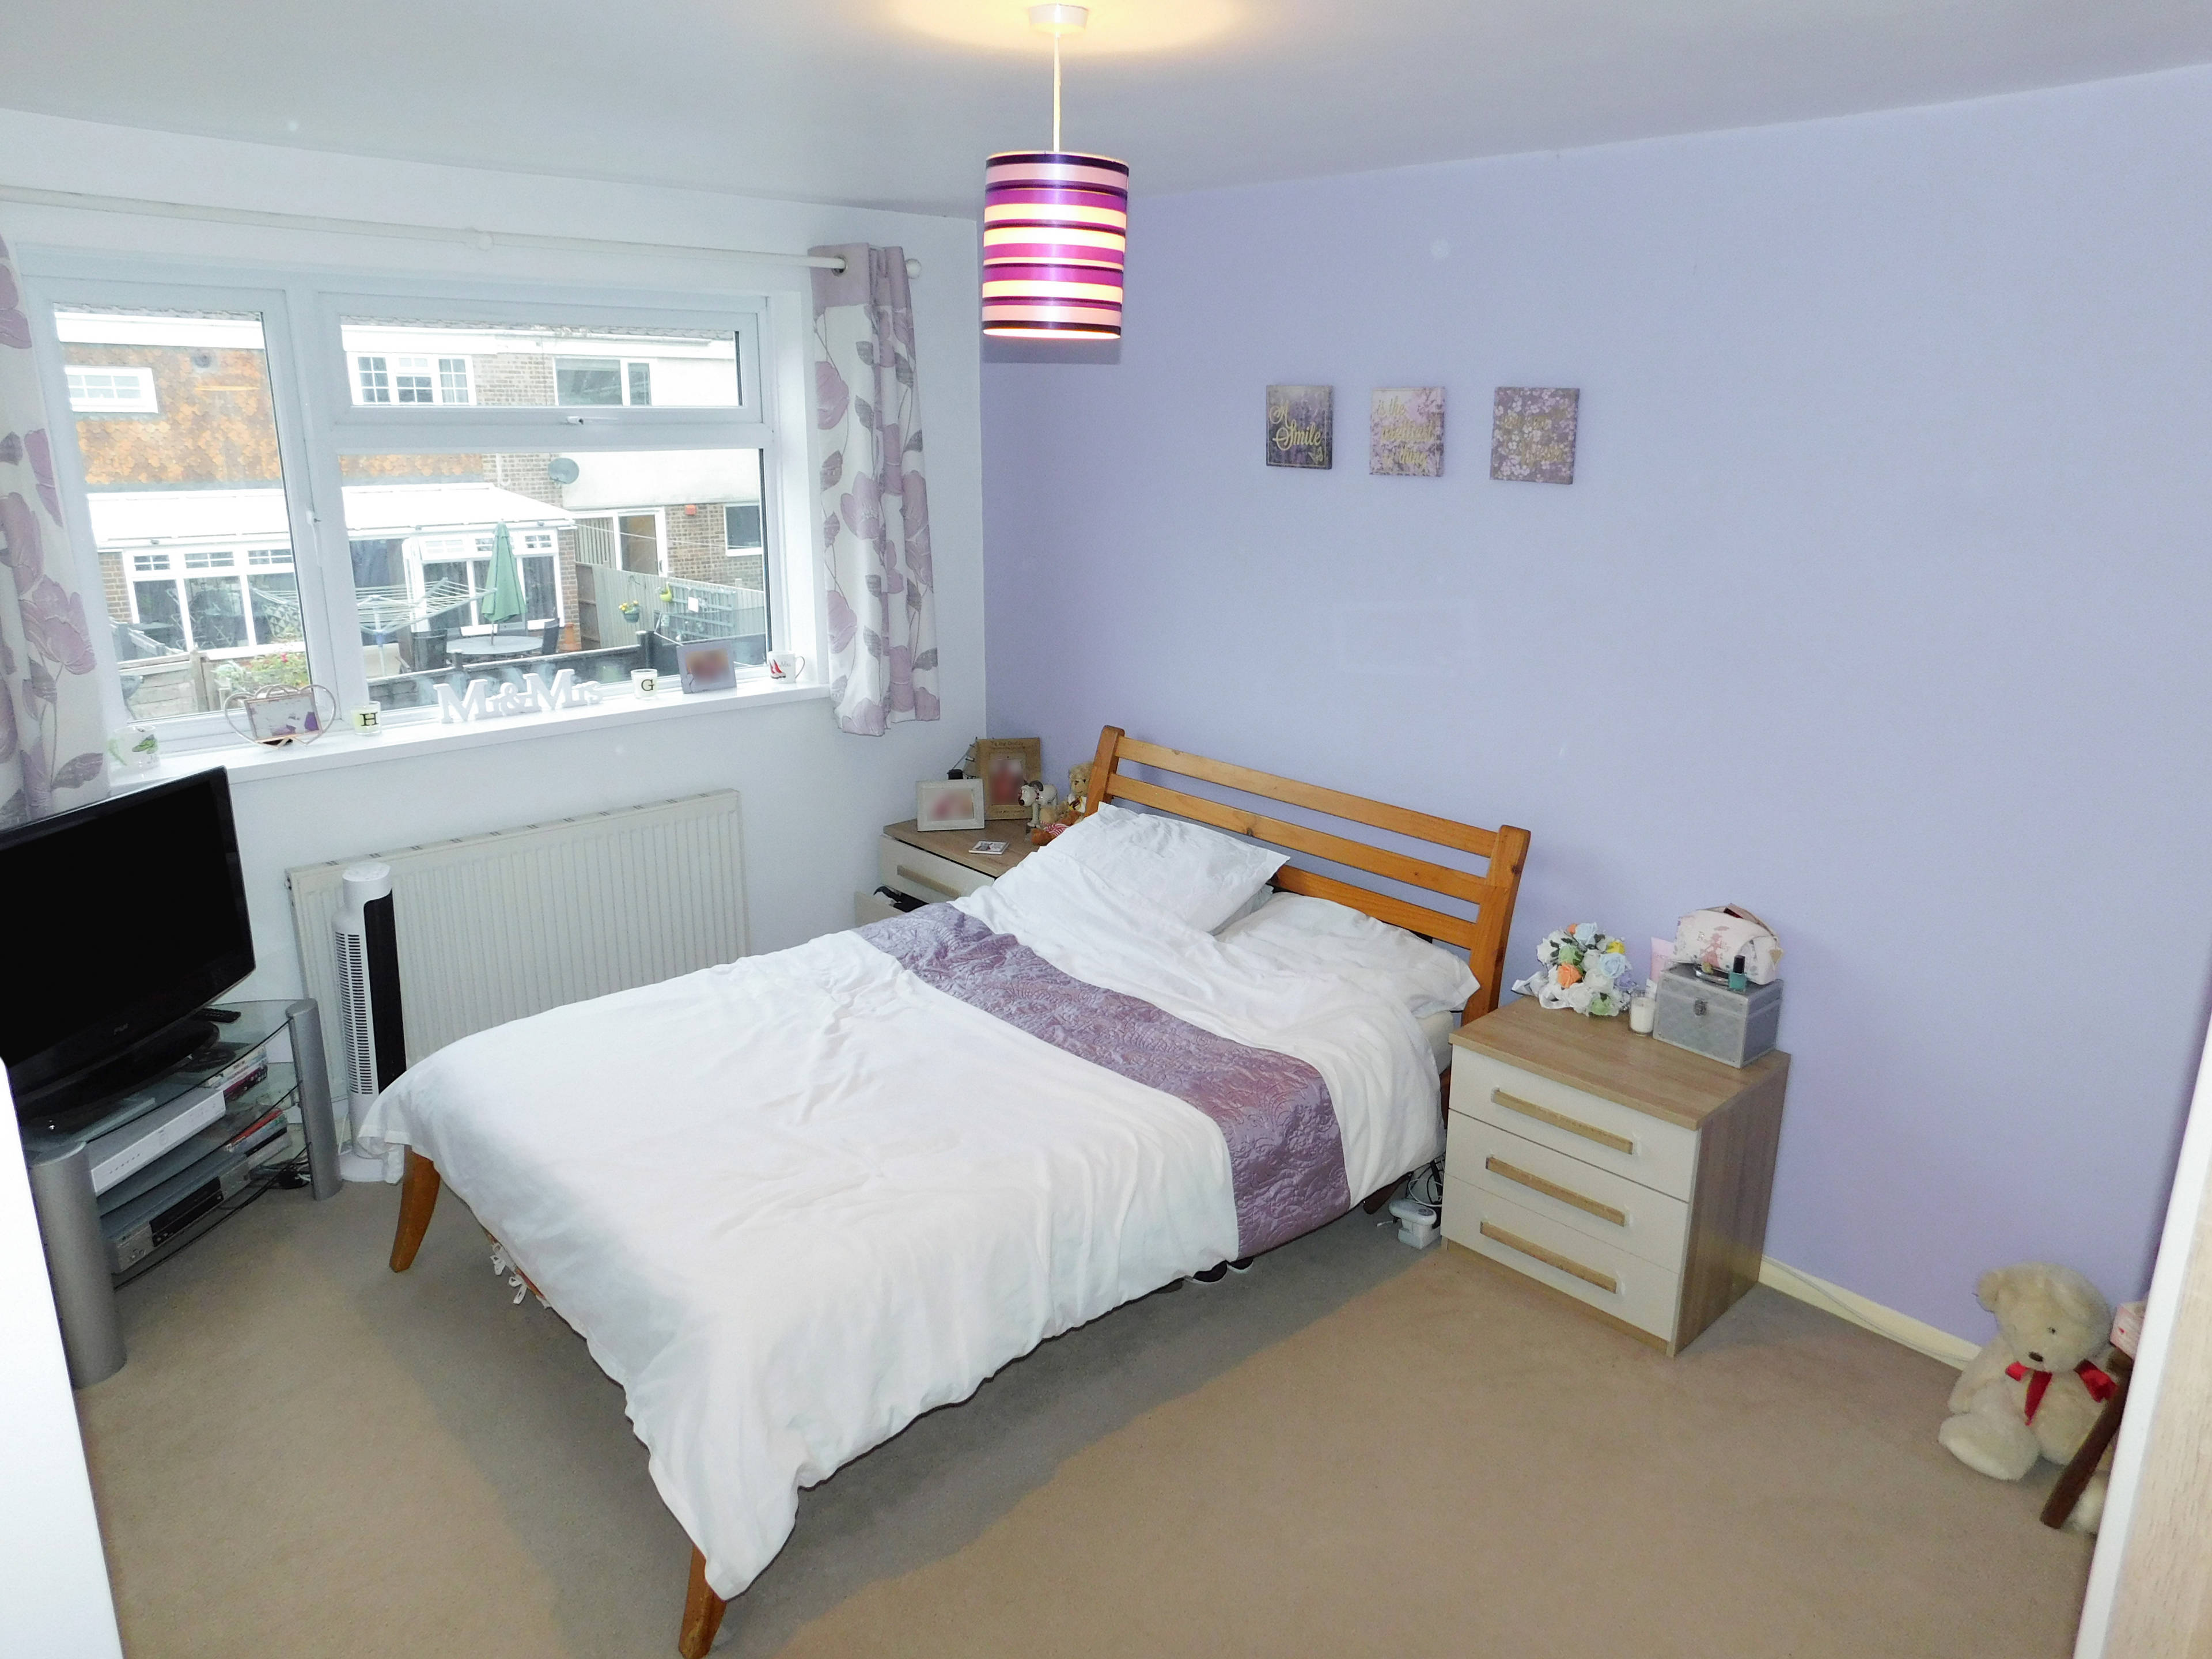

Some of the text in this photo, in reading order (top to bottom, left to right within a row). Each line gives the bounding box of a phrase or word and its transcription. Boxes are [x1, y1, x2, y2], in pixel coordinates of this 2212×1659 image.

[1271, 419, 1322, 451] Smile
[641, 679, 655, 691] G
[359, 711, 379, 726] H
